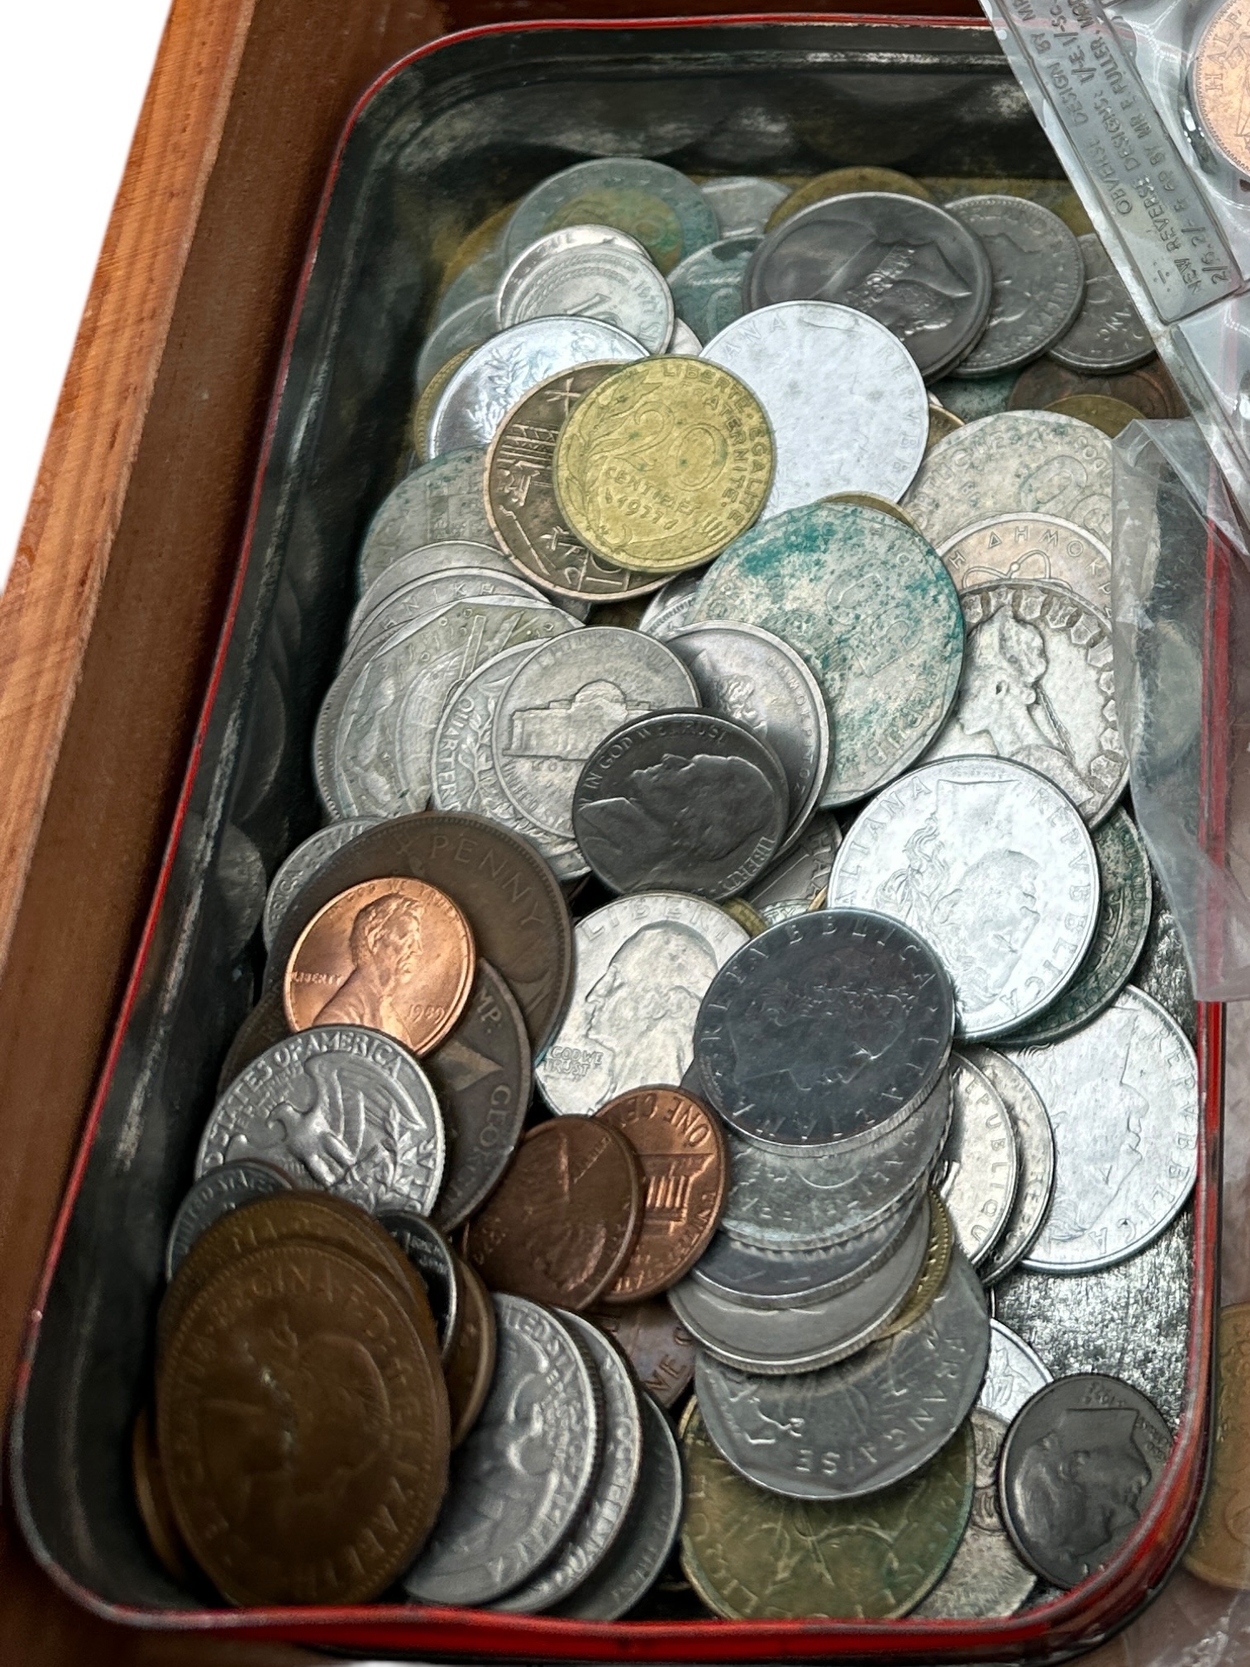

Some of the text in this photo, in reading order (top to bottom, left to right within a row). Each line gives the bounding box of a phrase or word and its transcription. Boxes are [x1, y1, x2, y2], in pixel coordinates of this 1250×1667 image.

[1030, 29, 1052, 53] BY
[1045, 60, 1089, 127] DESIGN
[1083, 136, 1135, 217] OBVERSE
[1144, 143, 1165, 166] BY
[1132, 175, 1182, 253] REVERSE
[1174, 254, 1204, 295] NEW
[661, 363, 752, 413] LIBERTE
[613, 401, 728, 492] 20
[988, 526, 1112, 617] ΔΗΜΟΚΡ
[440, 696, 475, 798] QUARTER
[600, 736, 633, 771] GOD
[432, 834, 545, 926] PENNY
[834, 775, 1092, 1019] ALIANA REPVBBLICA
[578, 897, 734, 942] LIBERT
[290, 971, 344, 985] LIBERTY
[303, 1031, 406, 1078] AMERICA
[663, 1096, 713, 1147] ONE
[964, 1076, 1008, 1242] EPUBLIQU
